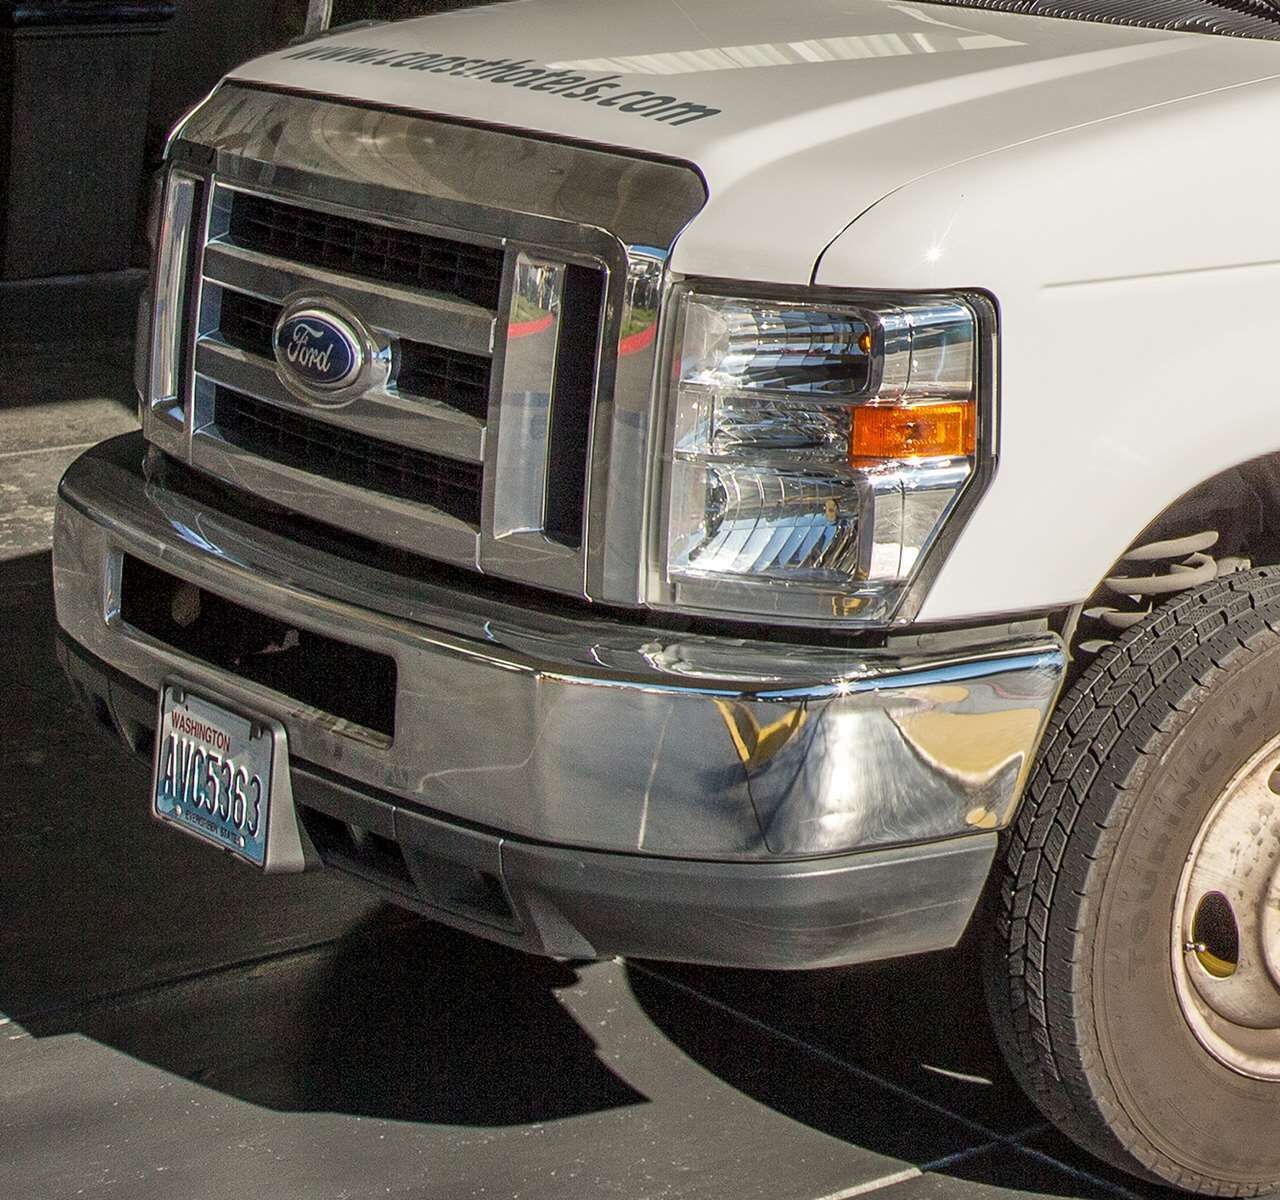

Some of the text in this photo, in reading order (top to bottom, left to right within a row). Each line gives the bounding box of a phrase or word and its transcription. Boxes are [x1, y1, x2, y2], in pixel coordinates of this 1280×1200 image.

[281, 44, 723, 127] www.coasthotels.com
[286, 322, 332, 374] Ford
[171, 709, 231, 753] WASHINGTON
[164, 732, 263, 838] AVC5363
